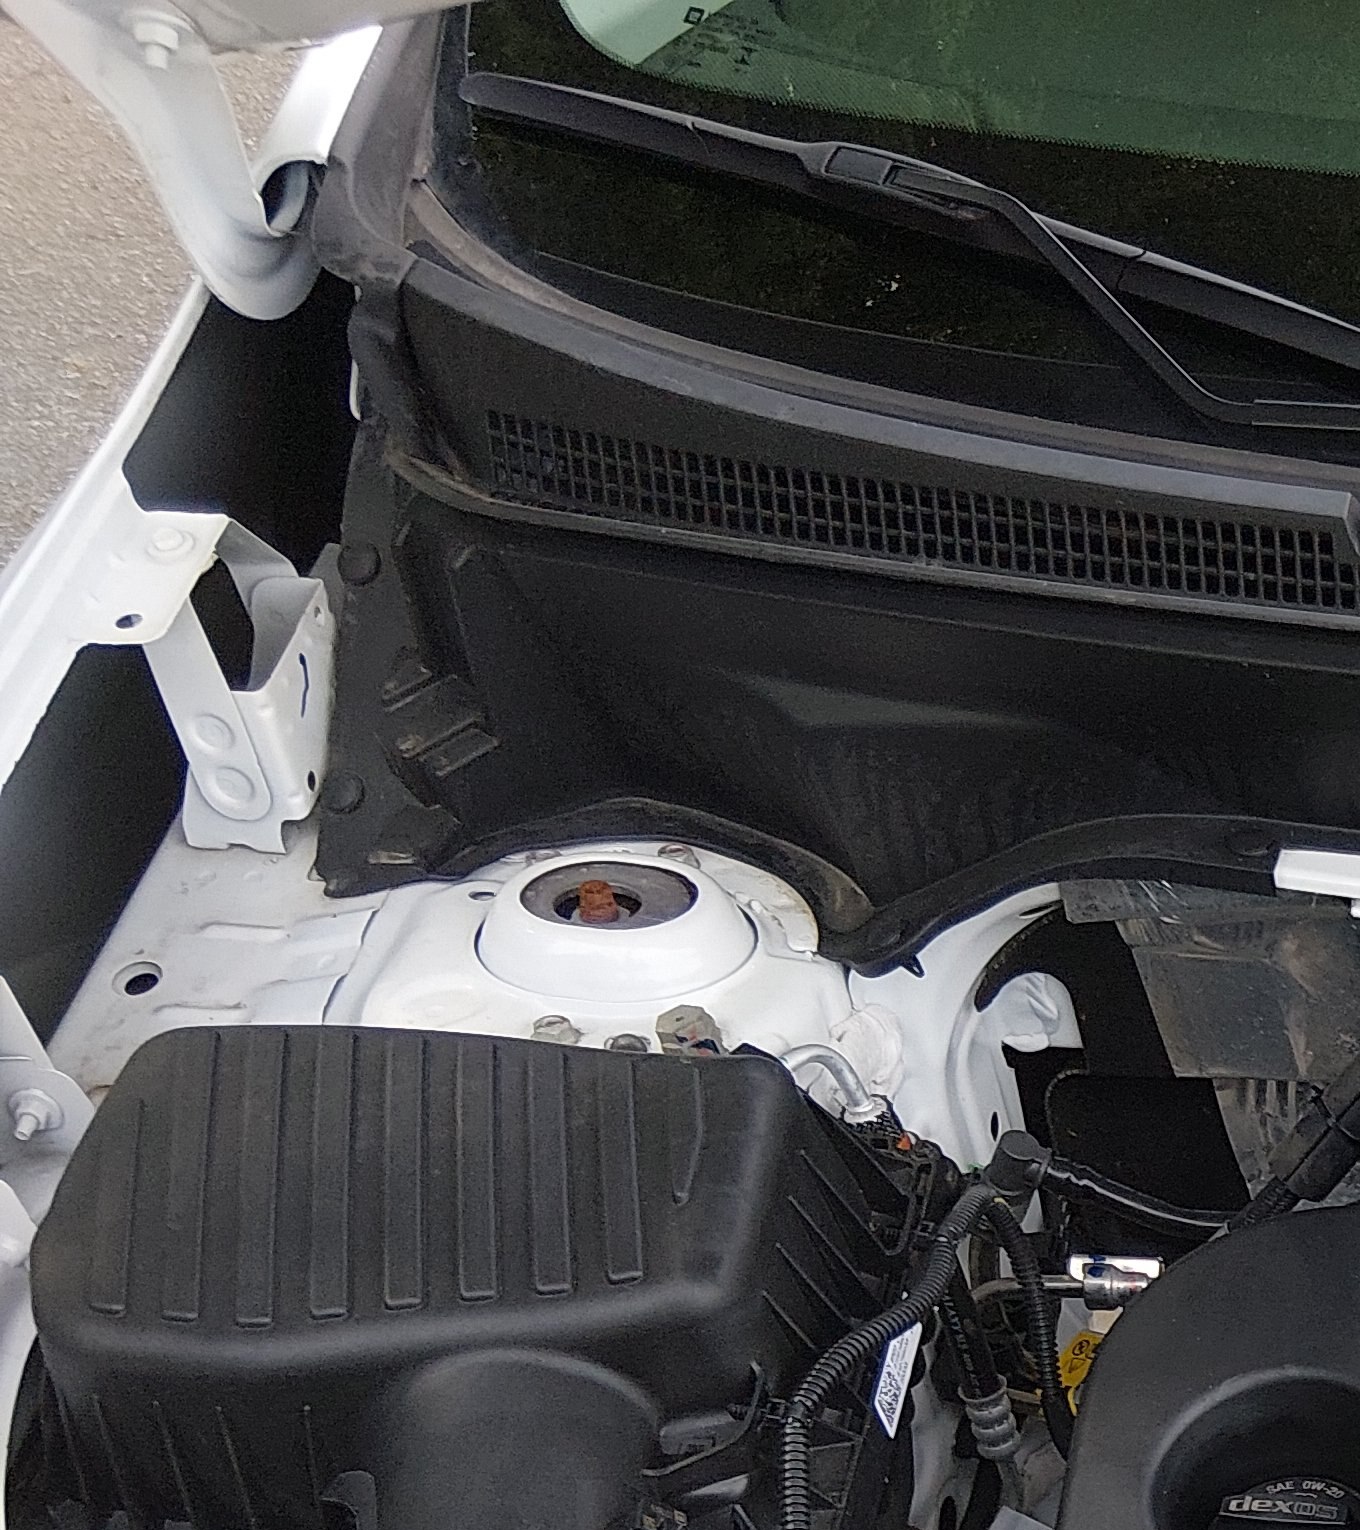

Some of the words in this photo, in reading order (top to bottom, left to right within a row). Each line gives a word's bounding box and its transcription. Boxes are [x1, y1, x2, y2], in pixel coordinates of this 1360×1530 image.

[1266, 1480, 1295, 1495] SAE
[1302, 1480, 1345, 1499] 0W-20
[1228, 1496, 1339, 1520] dexos
